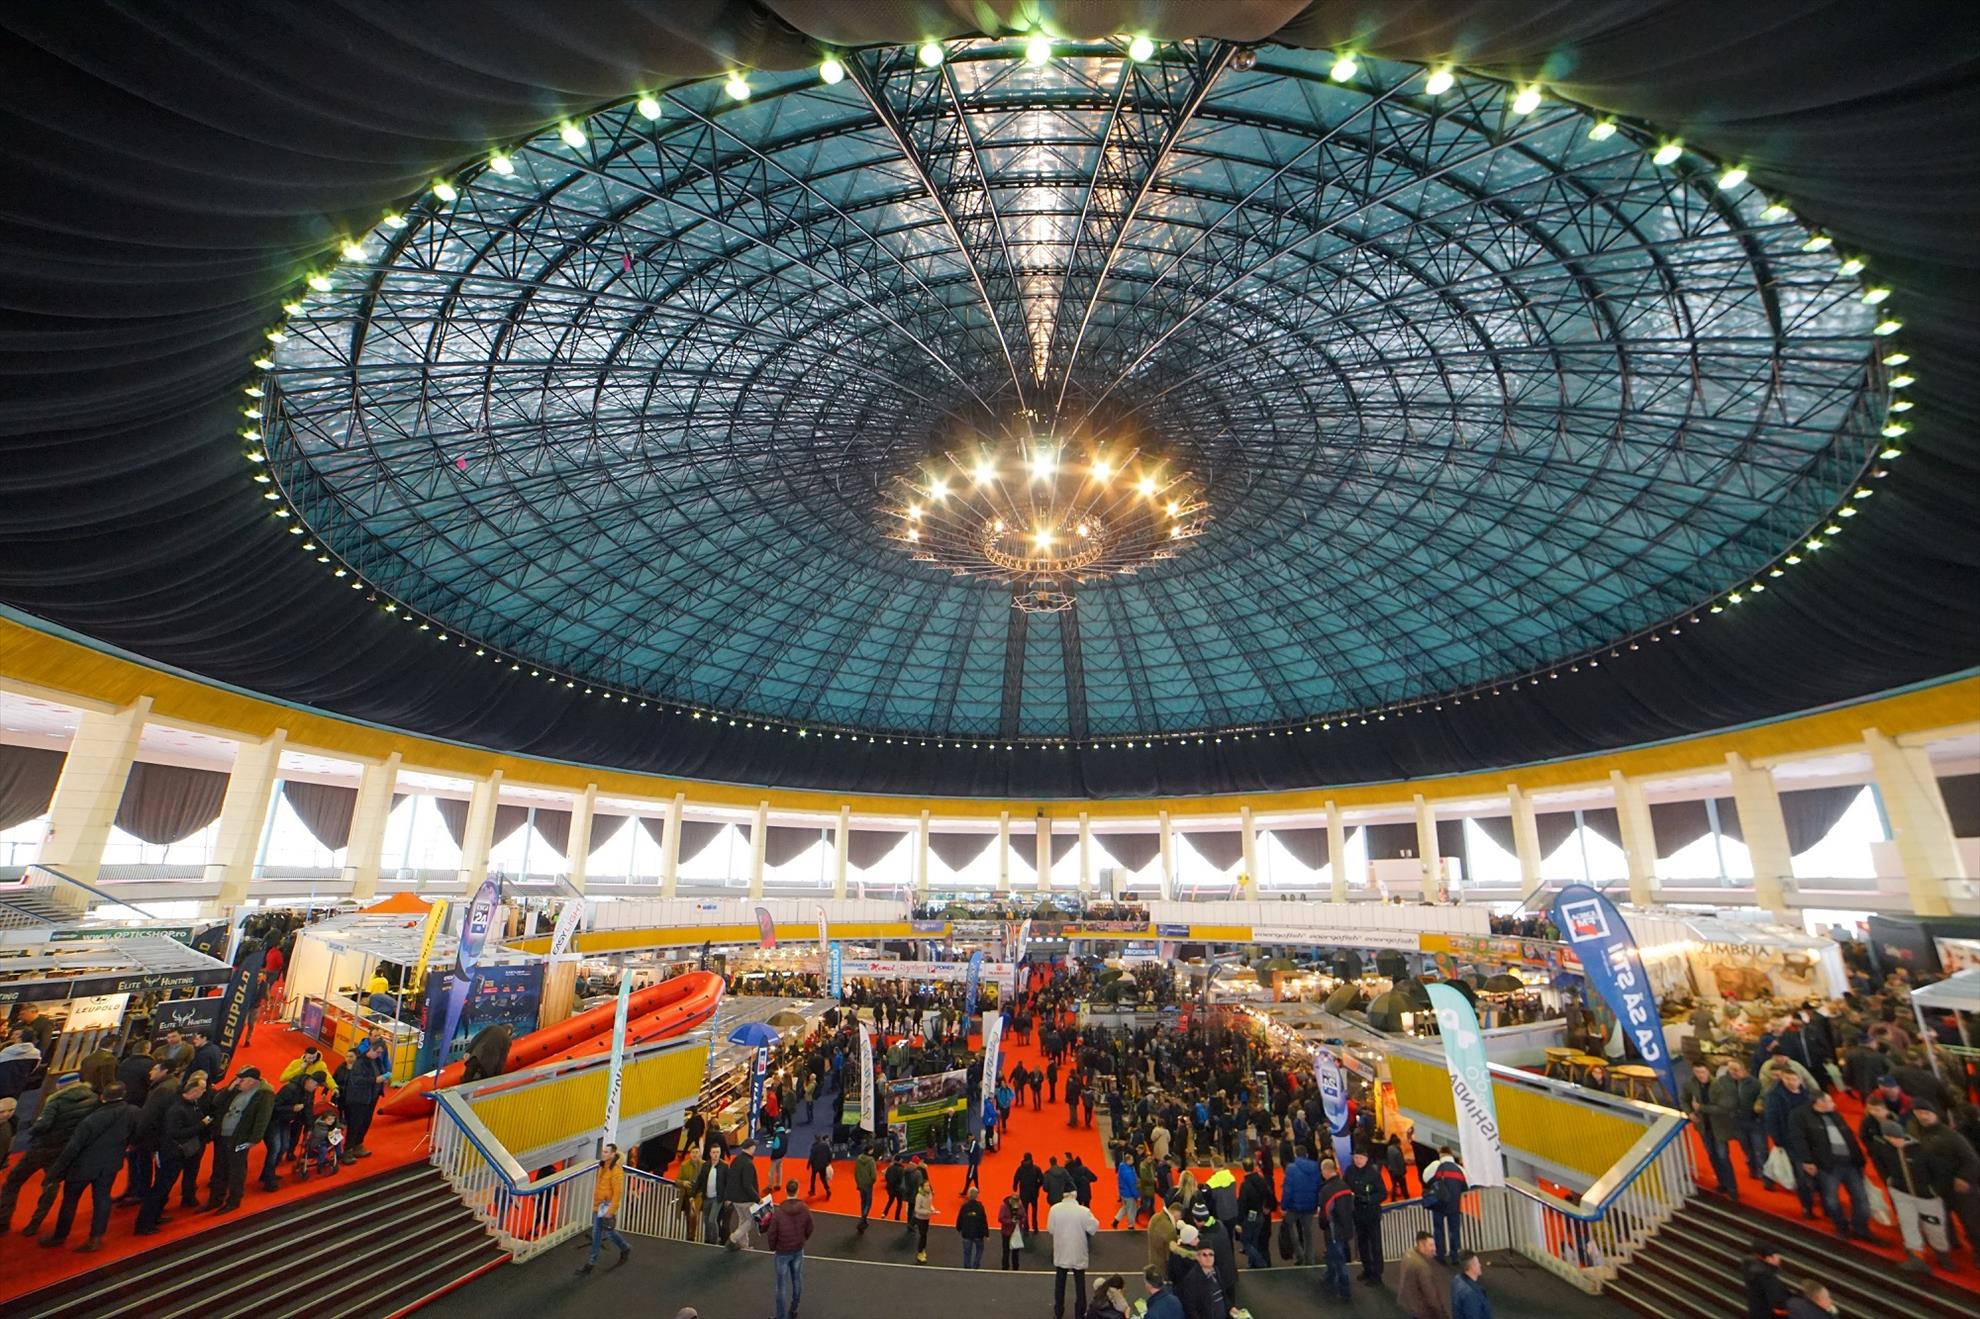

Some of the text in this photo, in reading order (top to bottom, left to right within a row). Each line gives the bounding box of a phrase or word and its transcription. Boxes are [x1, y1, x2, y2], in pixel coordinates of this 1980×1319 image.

[553, 902, 582, 956] EASYLIGHT
[1700, 942, 1770, 958] ZIMBRIA
[118, 976, 194, 991] ELITE HUNTING
[75, 1003, 121, 1015] LEUPOLD
[221, 970, 251, 1048] LEUPOLD
